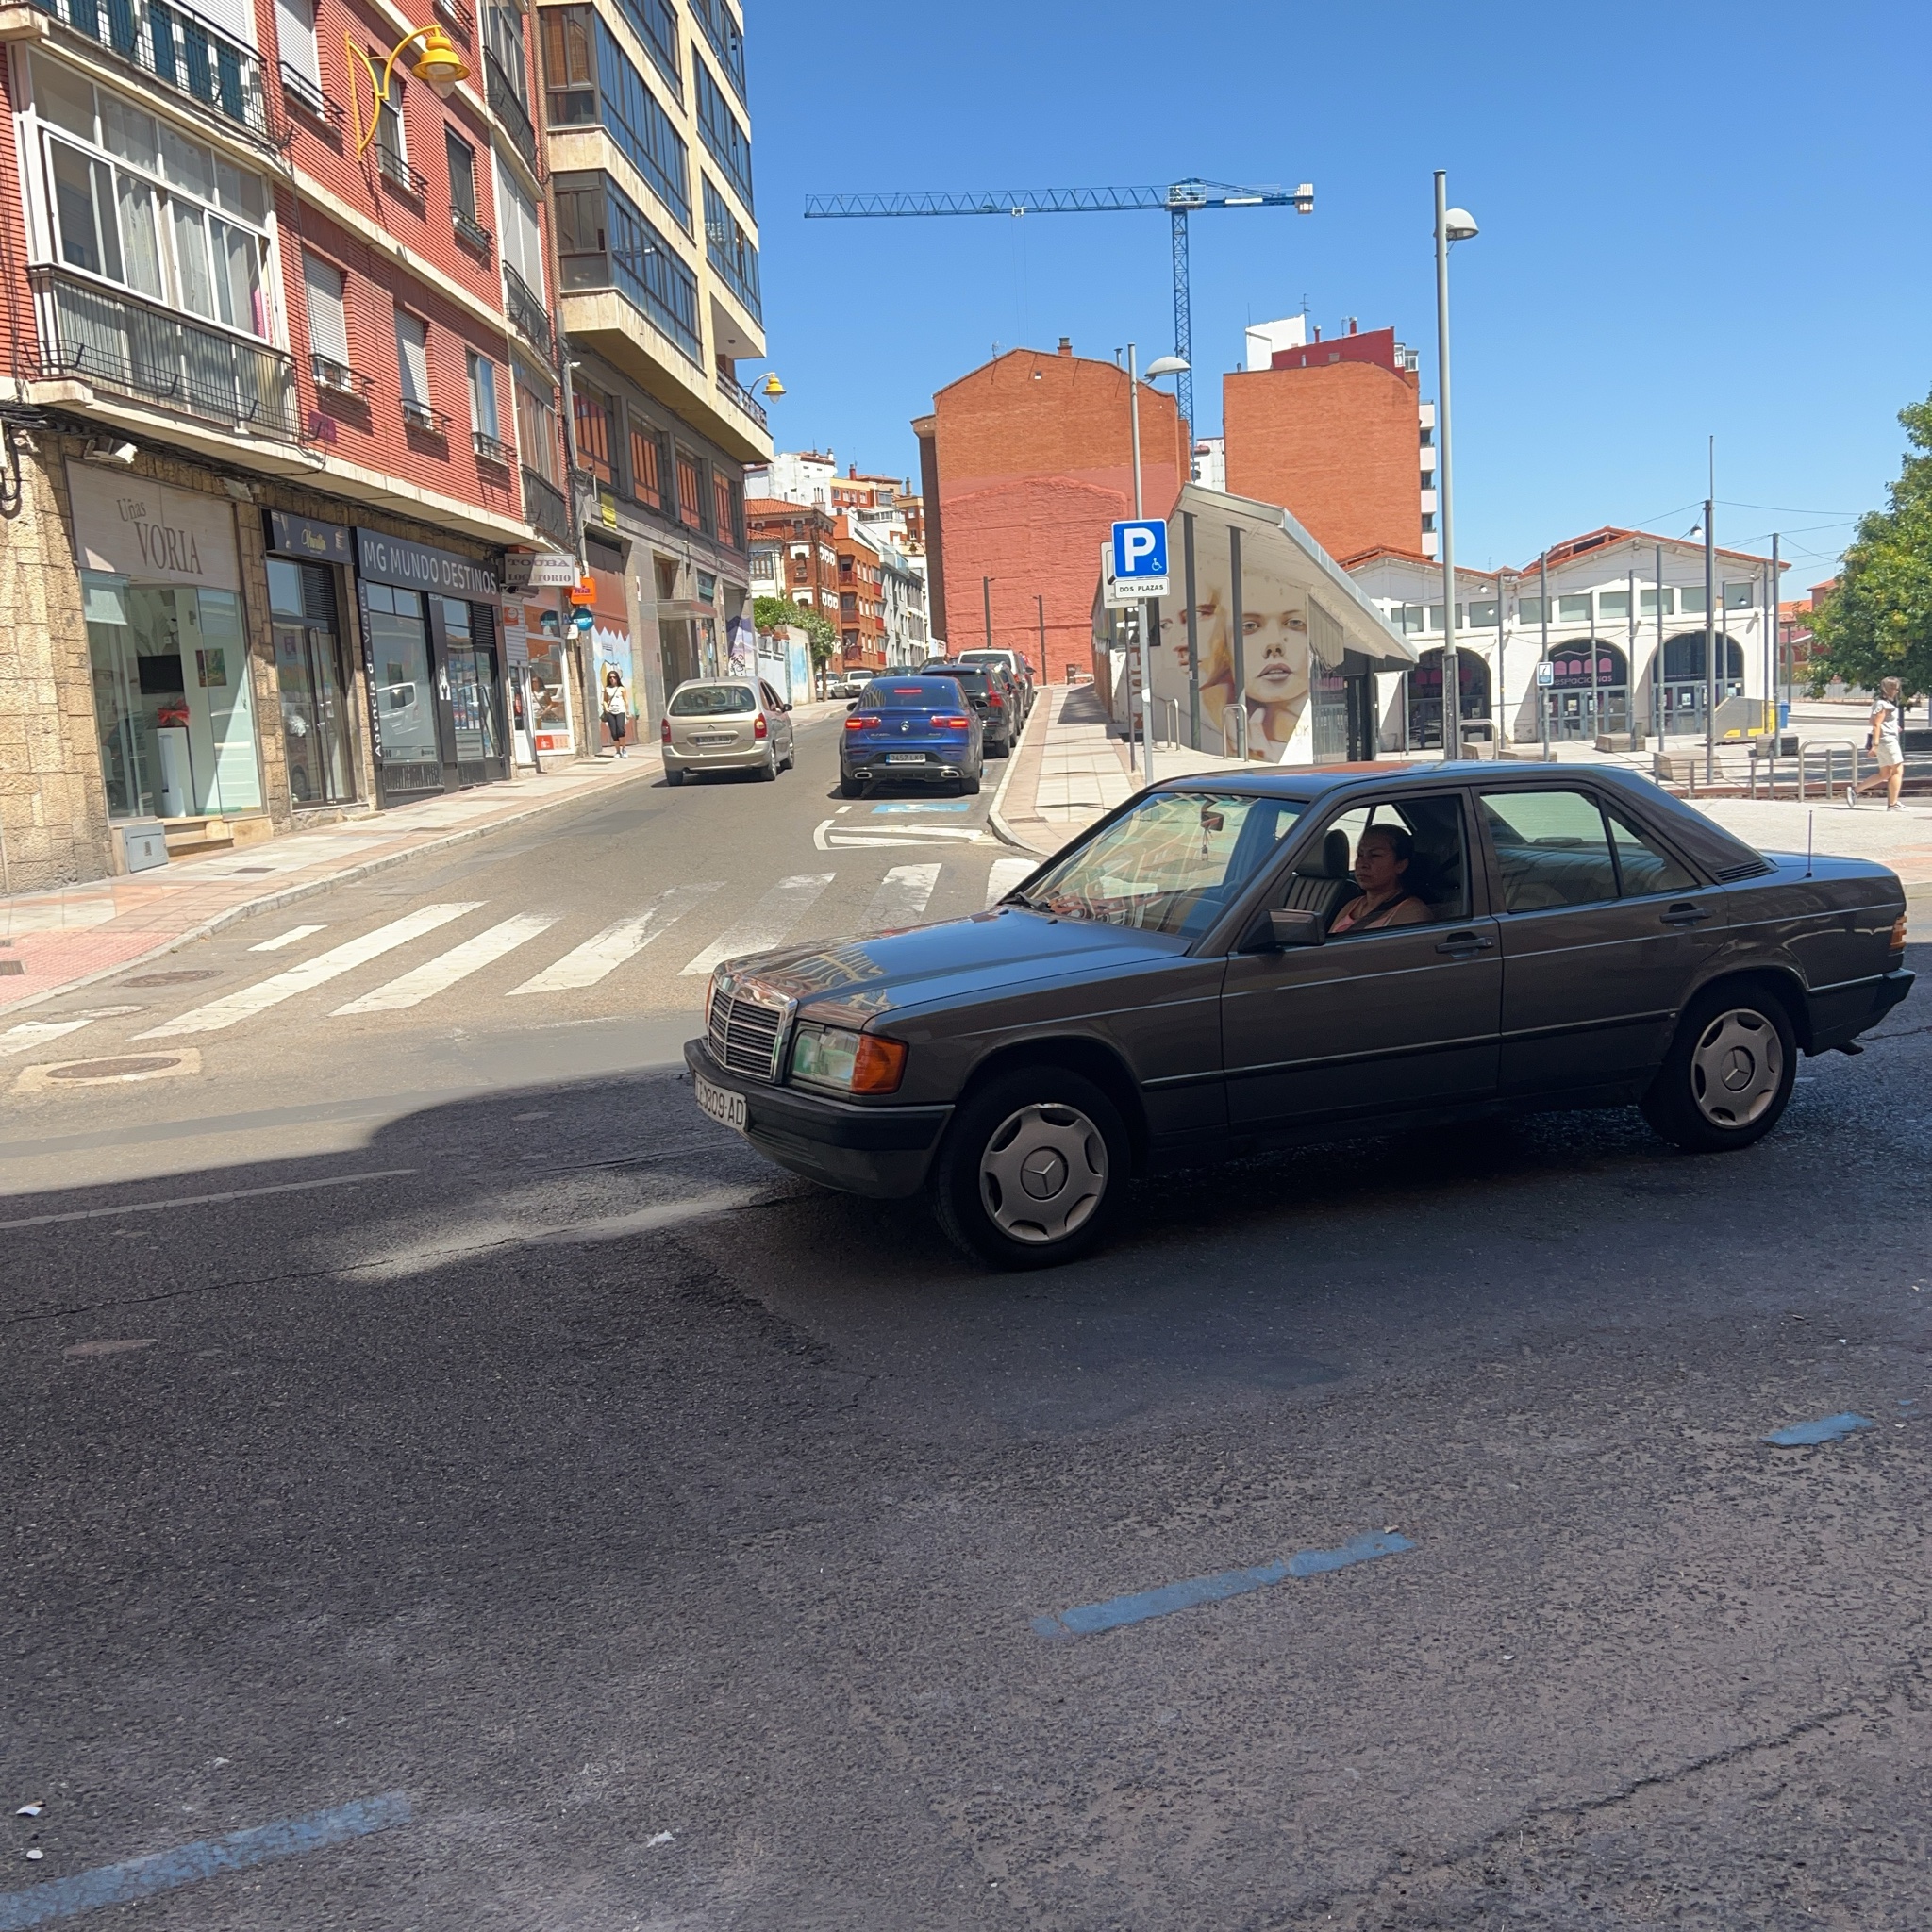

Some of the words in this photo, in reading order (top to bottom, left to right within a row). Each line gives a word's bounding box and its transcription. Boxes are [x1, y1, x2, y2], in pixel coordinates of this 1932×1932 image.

[116, 498, 146, 522] Uñas
[133, 521, 203, 575] VORIA
[363, 540, 387, 572] MG
[390, 546, 439, 584] MUNDO
[441, 559, 497, 596] DESTINOS
[507, 558, 570, 567] TOUBA
[1123, 527, 1156, 572] P
[1554, 675, 1613, 687] espacioias
[369, 681, 382, 758] Agencia
